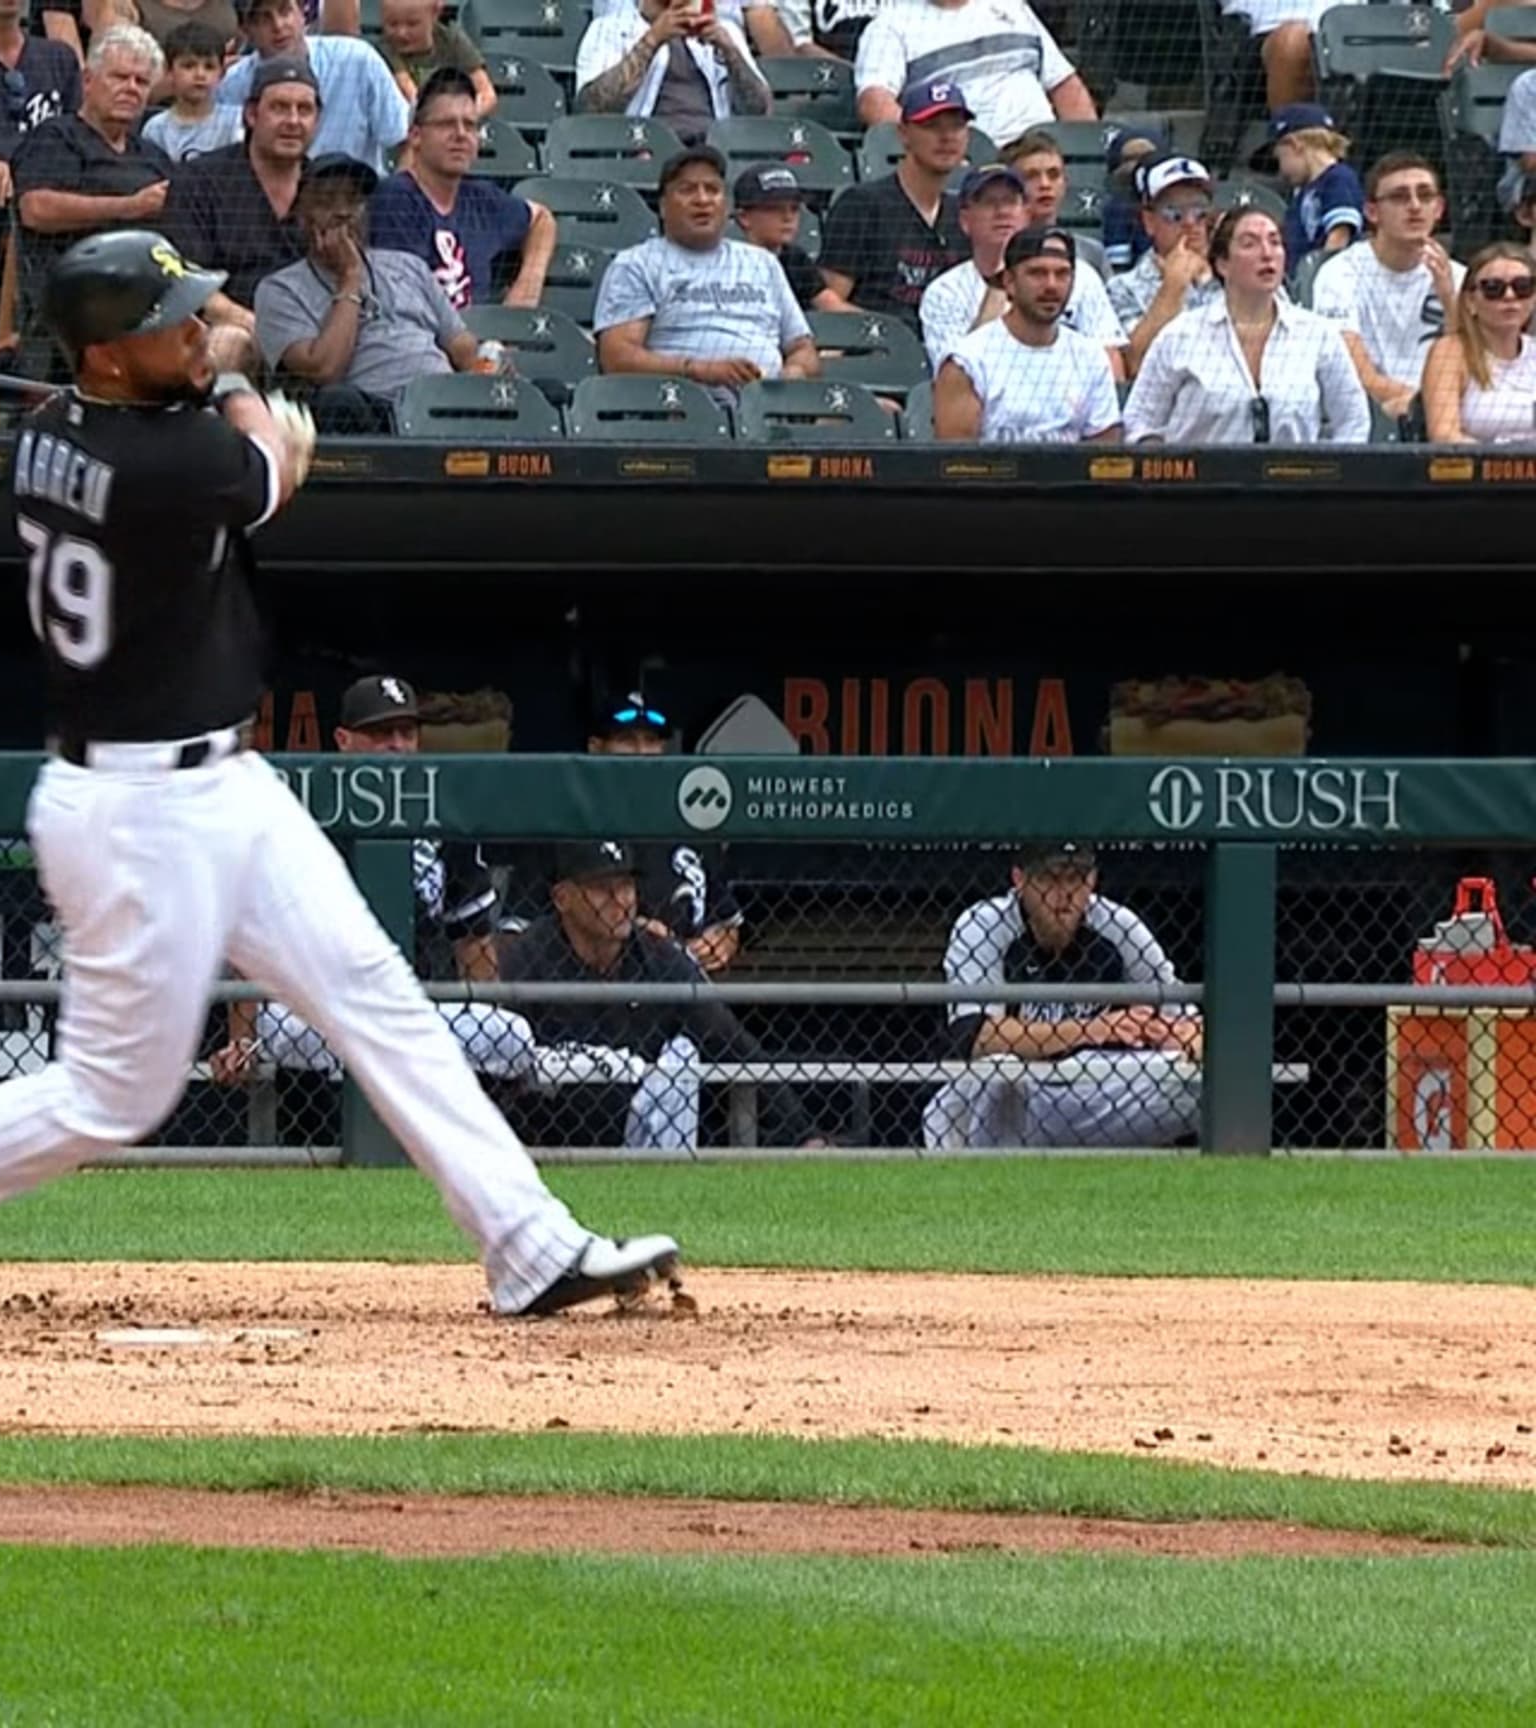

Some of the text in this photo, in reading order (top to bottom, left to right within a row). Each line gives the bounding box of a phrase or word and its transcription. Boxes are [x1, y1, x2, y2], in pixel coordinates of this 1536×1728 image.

[498, 454, 551, 475] BUONA
[820, 457, 873, 477] BUONA
[1141, 458, 1195, 480] BUONA
[1482, 459, 1536, 480] BUONA
[17, 511, 112, 671] 79
[747, 777, 846, 795] MIDWEST
[277, 765, 441, 829] USH
[1215, 768, 1400, 831] RUSH
[747, 802, 914, 819] ORTHOPAEDICS
